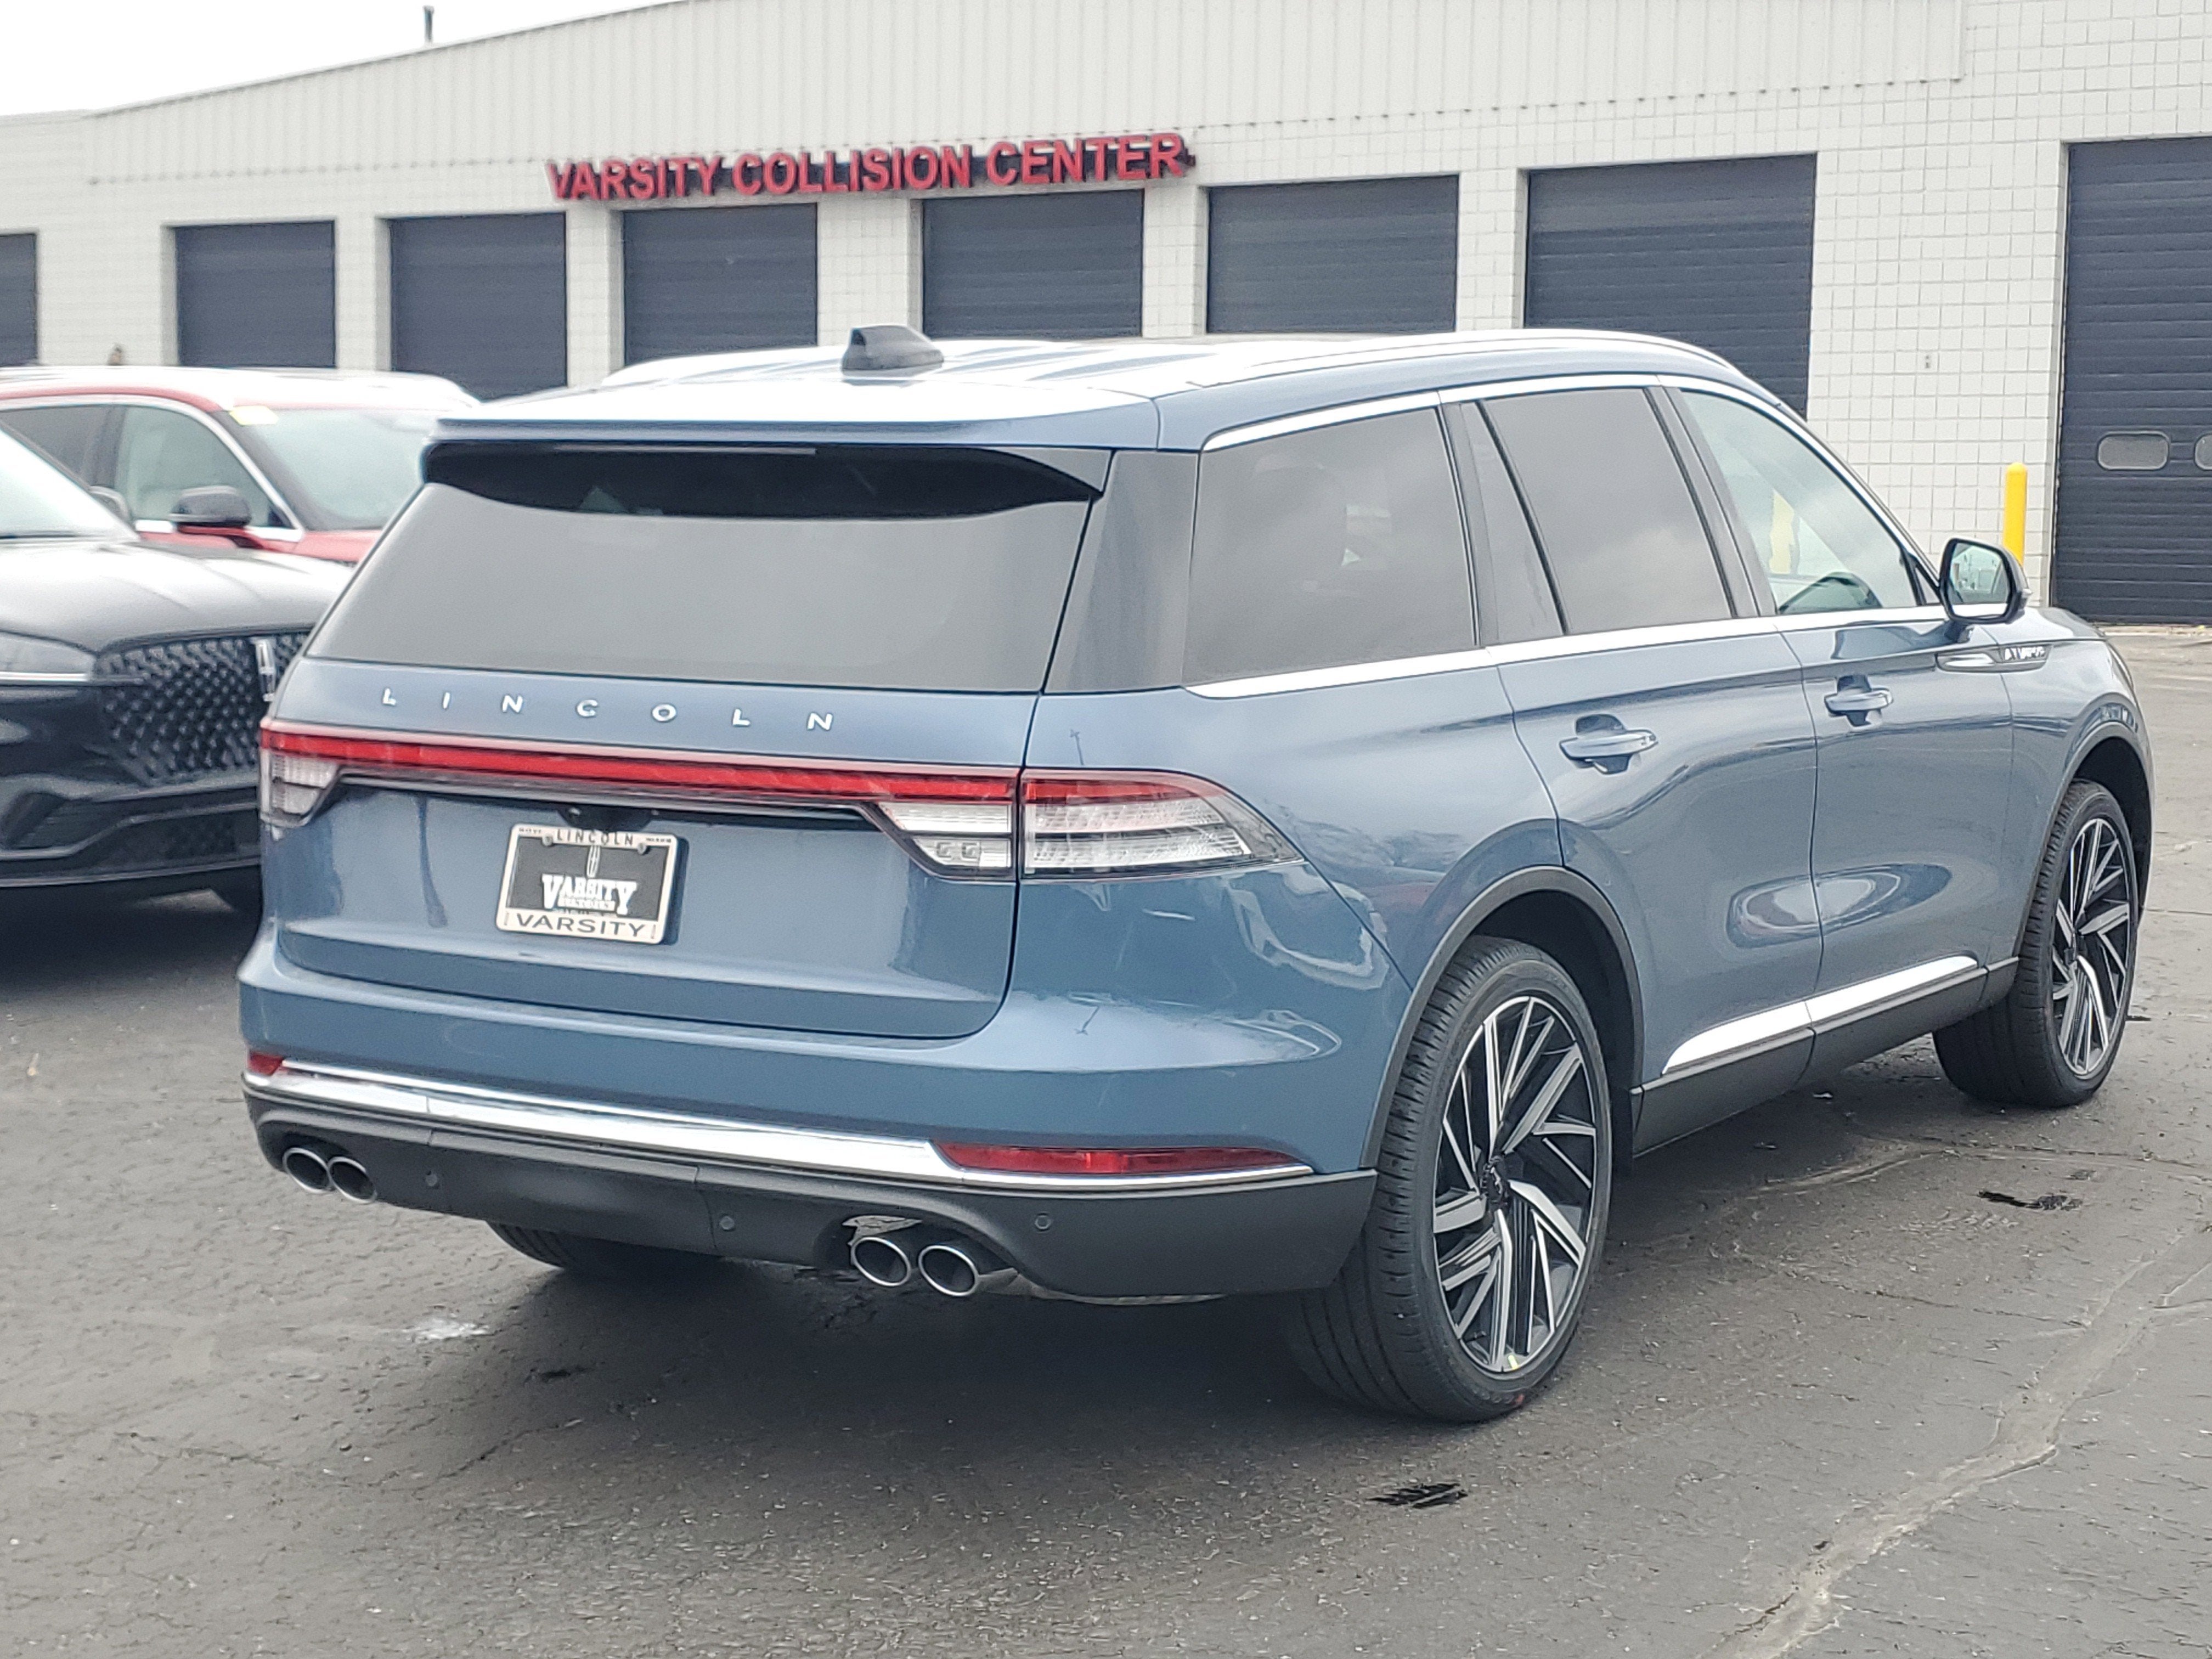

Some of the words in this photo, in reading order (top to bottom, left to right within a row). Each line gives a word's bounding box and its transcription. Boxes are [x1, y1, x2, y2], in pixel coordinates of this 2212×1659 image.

[549, 156, 722, 200] VARSITY
[732, 145, 972, 195] COLLISION
[985, 132, 1184, 185] CENTER
[382, 687, 833, 731] LINCOLN
[557, 829, 634, 846] LINCOLN
[541, 873, 637, 915] VARSITY
[516, 913, 645, 937] VARSITY
